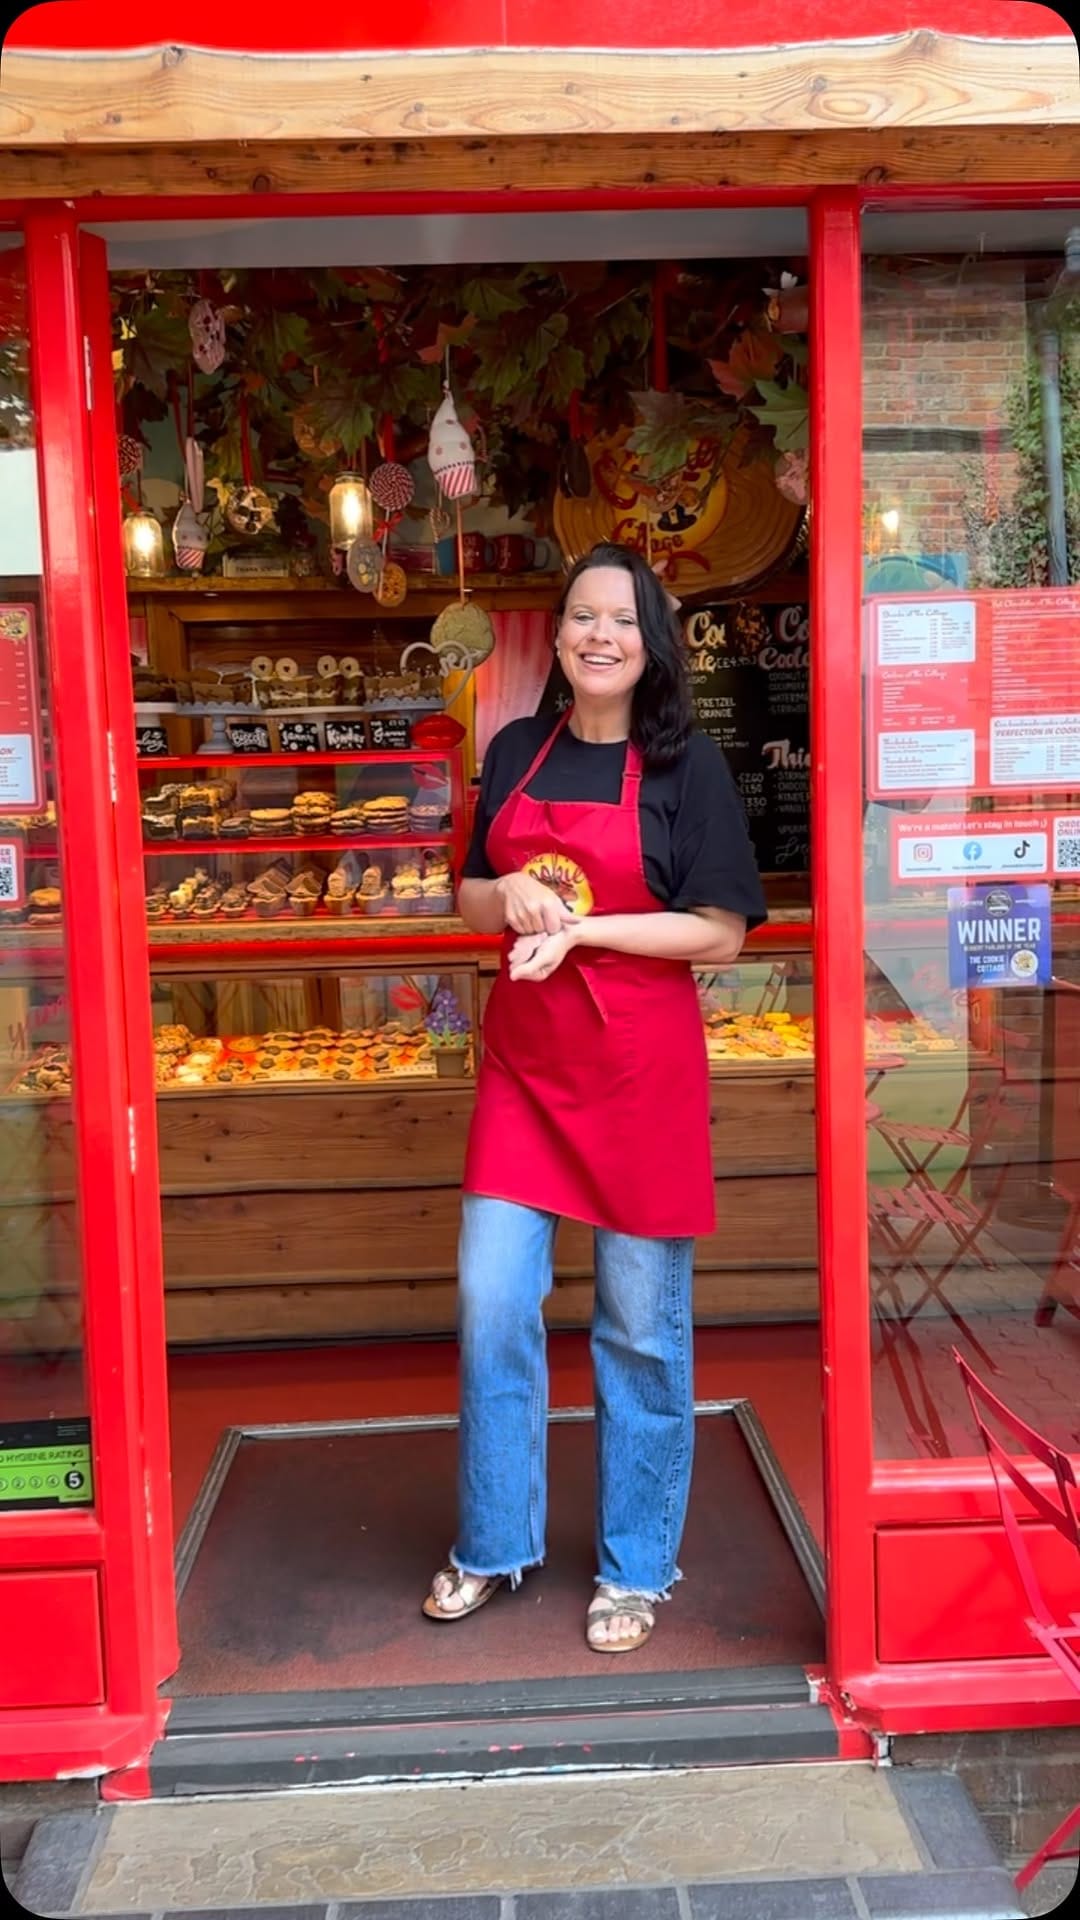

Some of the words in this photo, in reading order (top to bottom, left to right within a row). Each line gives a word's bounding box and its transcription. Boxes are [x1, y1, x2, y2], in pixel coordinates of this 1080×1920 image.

[898, 823, 922, 833] We're
[931, 822, 960, 831] match!
[963, 820, 982, 830] Let's
[984, 820, 1002, 831] stay
[1003, 820, 1012, 829] in
[1014, 819, 1039, 829] touch
[957, 917, 1041, 944] WINNER
[969, 955, 981, 964] THE
[983, 954, 1005, 963] COOKIE
[976, 964, 1005, 973] COTTAGE
[68, 1472, 81, 1488] 5
